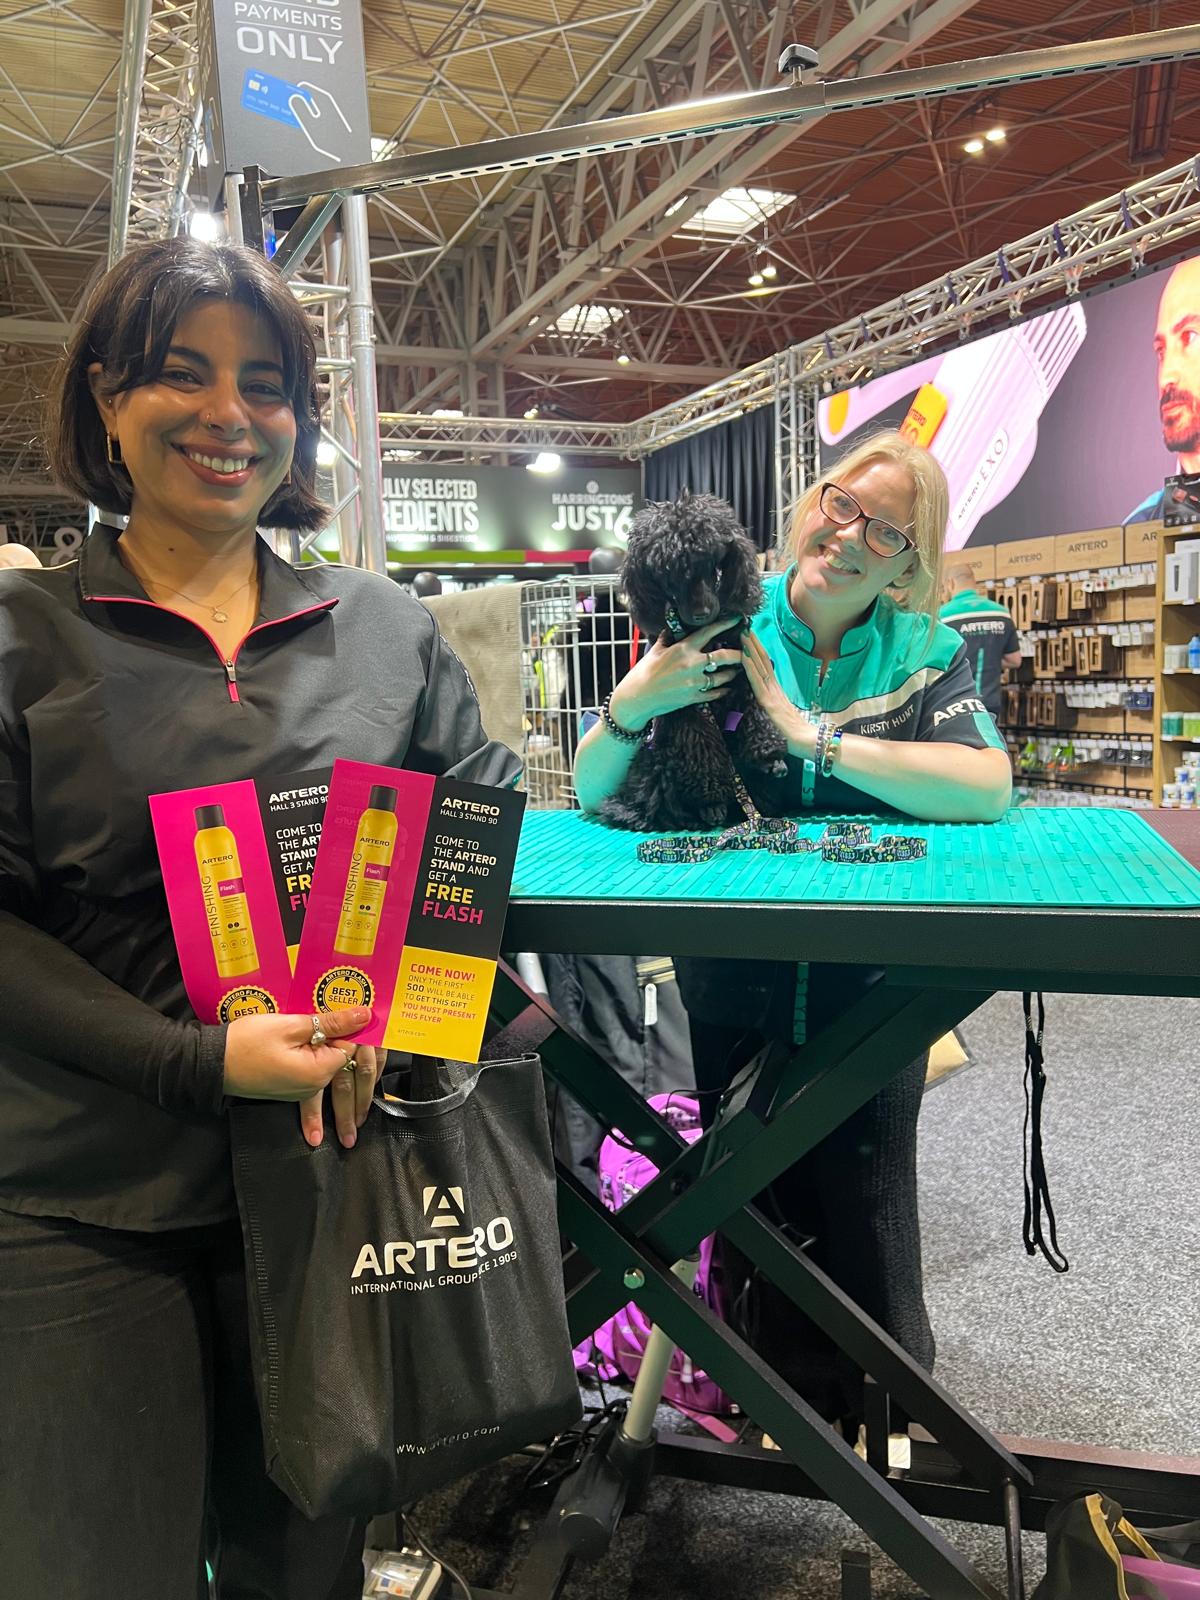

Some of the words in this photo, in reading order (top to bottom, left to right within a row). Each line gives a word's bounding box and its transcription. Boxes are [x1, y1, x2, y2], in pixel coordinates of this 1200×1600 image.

[234, 2, 342, 30] PAYMENTS
[236, 26, 343, 64] ONLY
[411, 478, 478, 500] SELECTED
[1068, 539, 1108, 554] ARTERO
[1008, 552, 1042, 565] ARTERO
[960, 621, 1005, 633] ARTERO
[860, 720, 890, 735] KIRSTY
[892, 704, 914, 728] HUNT
[269, 785, 329, 803] ARTERO
[270, 803, 289, 812] HALL
[290, 801, 296, 809] 3
[296, 797, 319, 808] STAND
[441, 797, 500, 816] ARTERO
[440, 808, 458, 818] HALL
[458, 811, 464, 819] 3
[464, 812, 486, 823] STAND
[488, 816, 498, 825] 90
[276, 825, 306, 839] COME
[308, 822, 322, 834] TO
[278, 839, 299, 851] THE
[360, 837, 390, 847] ARTERO
[435, 834, 465, 848] COME
[466, 839, 479, 851] TO
[202, 854, 234, 865] ARTERO
[280, 848, 317, 863] STAND
[433, 846, 453, 858] THE
[454, 850, 497, 866] ARTERO
[283, 862, 302, 875] GET
[306, 861, 314, 870] A
[365, 867, 381, 876] Flash
[430, 858, 466, 872] STAND
[466, 865, 490, 877] AND
[342, 852, 363, 913] FINISHING
[428, 870, 448, 882] GET
[449, 874, 457, 884] A
[219, 884, 236, 892] Flash
[425, 882, 474, 905] FREE
[201, 875, 221, 937] FINISHING
[422, 900, 484, 925] FLASH
[325, 970, 350, 982] ARTERO
[350, 971, 368, 987] FLASH
[410, 963, 442, 977] COME
[444, 968, 476, 982] NOW!
[408, 974, 427, 984] ONLY
[428, 977, 443, 986] THE
[444, 980, 464, 989] FIRST
[223, 990, 245, 1008] ARTERO
[245, 989, 267, 1001] FLASH
[328, 995, 359, 1005] SELLER
[332, 987, 357, 998] BEST
[407, 983, 425, 992] 500
[426, 987, 444, 996] WILL
[445, 990, 455, 998] BE
[457, 992, 476, 1001] ABLE
[405, 993, 414, 1001] TO
[432, 997, 449, 1006] THIS
[450, 1000, 467, 1009] GIFT
[234, 1005, 259, 1018] BEST
[401, 1011, 418, 1020] THIS
[420, 1014, 442, 1023] FLYER
[403, 1002, 418, 1011] YOU
[420, 1004, 441, 1014] MUST
[442, 1008, 476, 1020] PRESENT
[351, 1216, 514, 1278] ARTERO
[351, 1278, 435, 1295] INTERNATIONAL
[438, 1272, 477, 1286] GROUP
[492, 1251, 517, 1268] 1909
